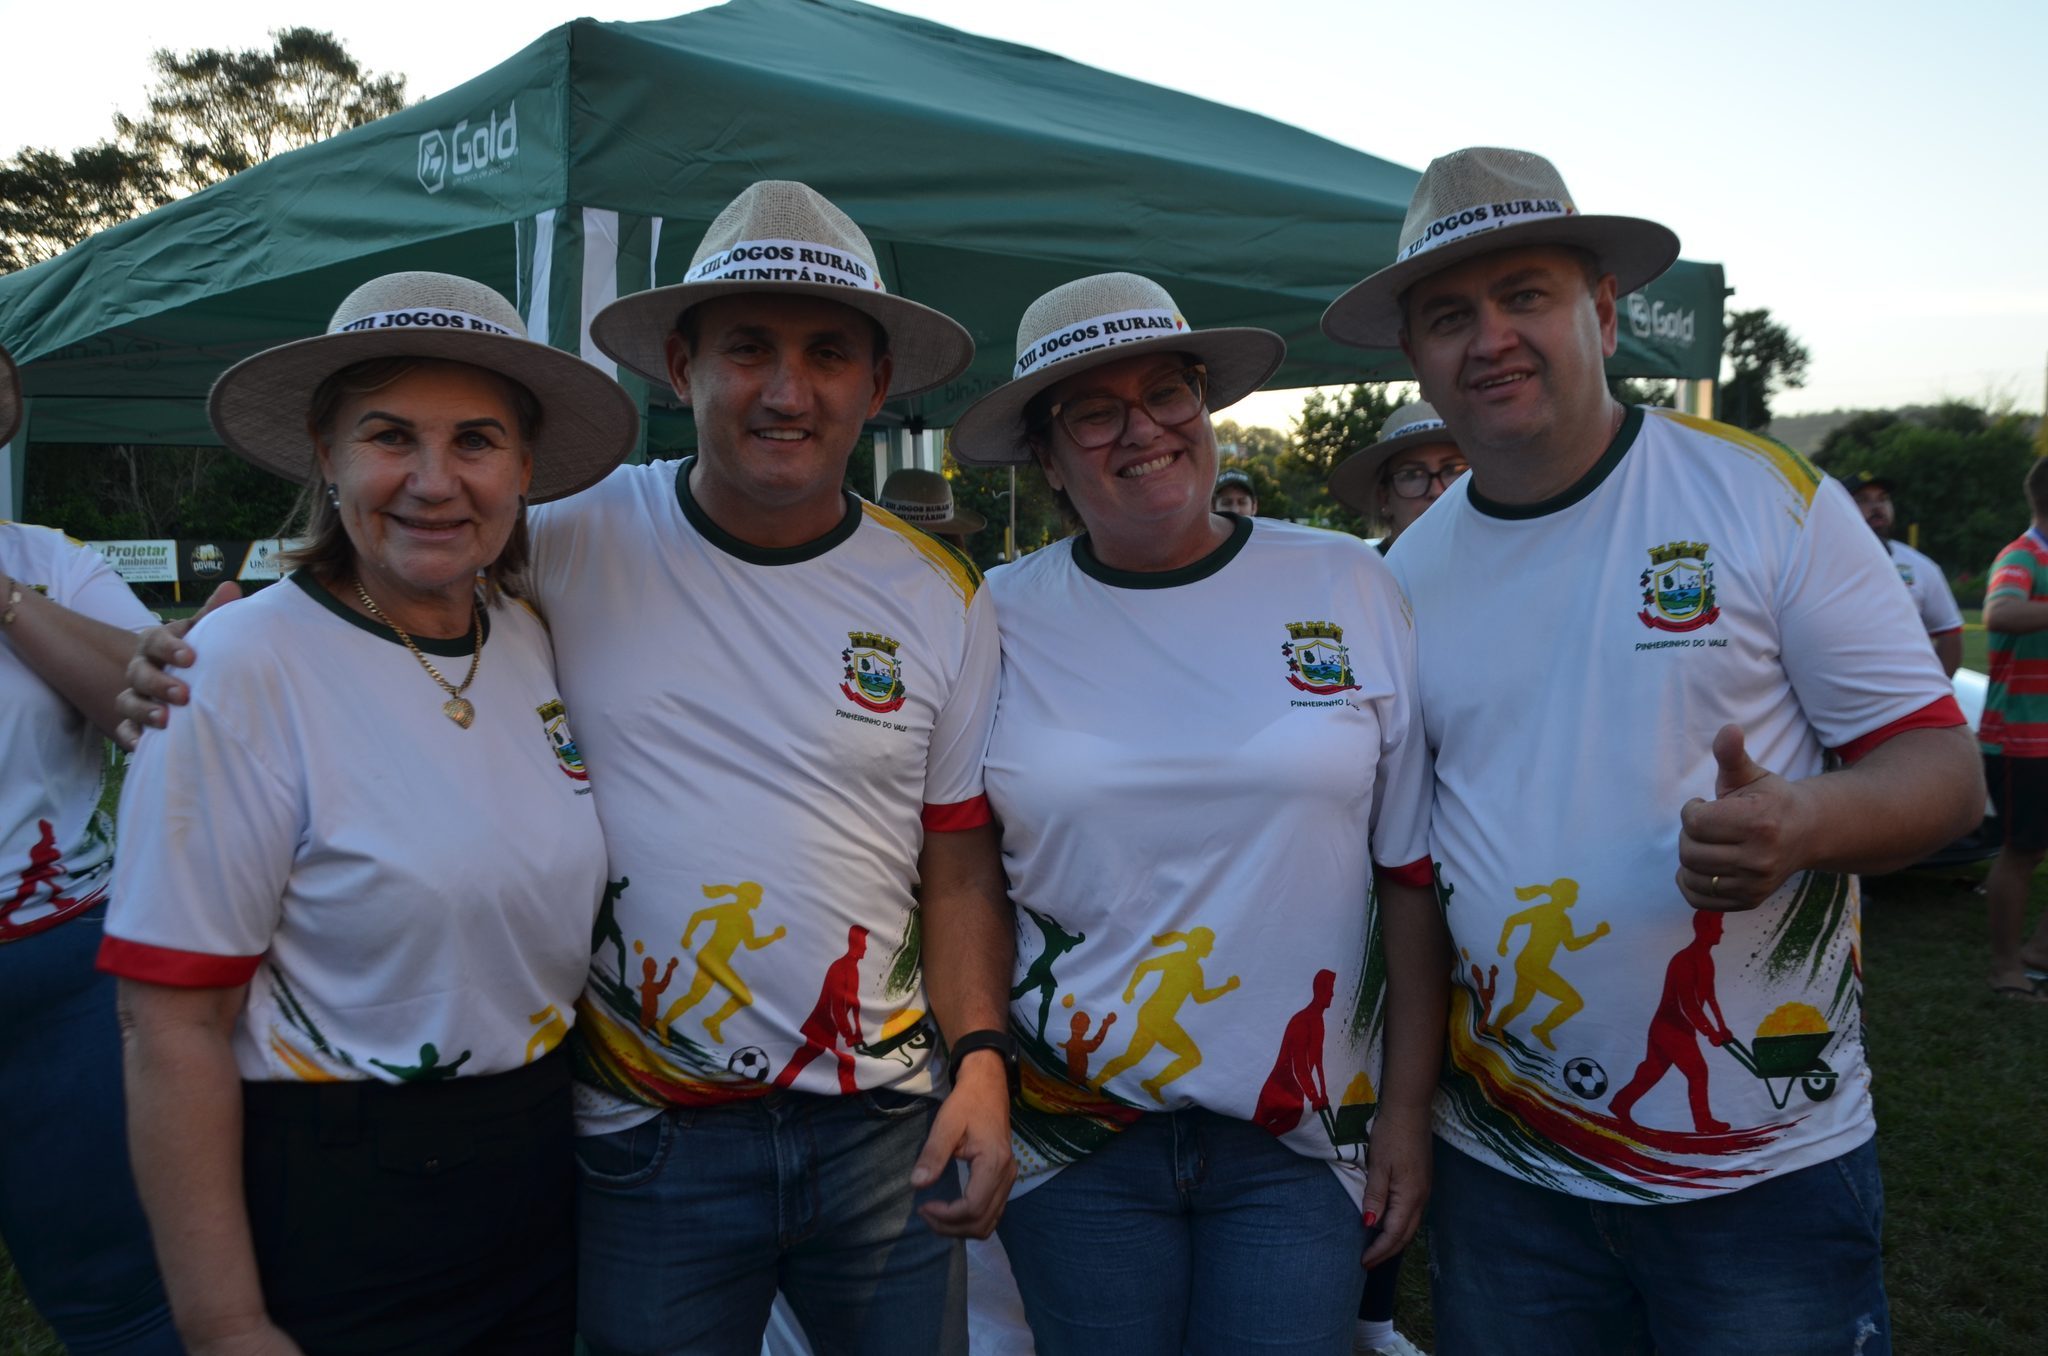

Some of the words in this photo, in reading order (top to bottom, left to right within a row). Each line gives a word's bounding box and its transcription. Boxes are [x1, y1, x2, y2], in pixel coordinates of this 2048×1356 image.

[1424, 206, 1488, 242] JOGOS
[722, 246, 794, 265] JOGOS
[799, 248, 867, 280] RURAIS
[380, 312, 464, 328] JOGOS
[1018, 348, 1037, 373] XIII
[1038, 325, 1099, 357] JOGOS
[1103, 316, 1173, 335] RURAIS
[106, 545, 168, 557] Projetar
[118, 558, 167, 566] Ambiental
[1635, 639, 1691, 652] PINHEIRINHO
[1692, 639, 1705, 648] DO
[1708, 639, 1728, 648] VALE
[1290, 699, 1344, 708] PINHEIRINHO
[835, 708, 881, 727] PINHEIRINHO
[882, 721, 893, 730] DO
